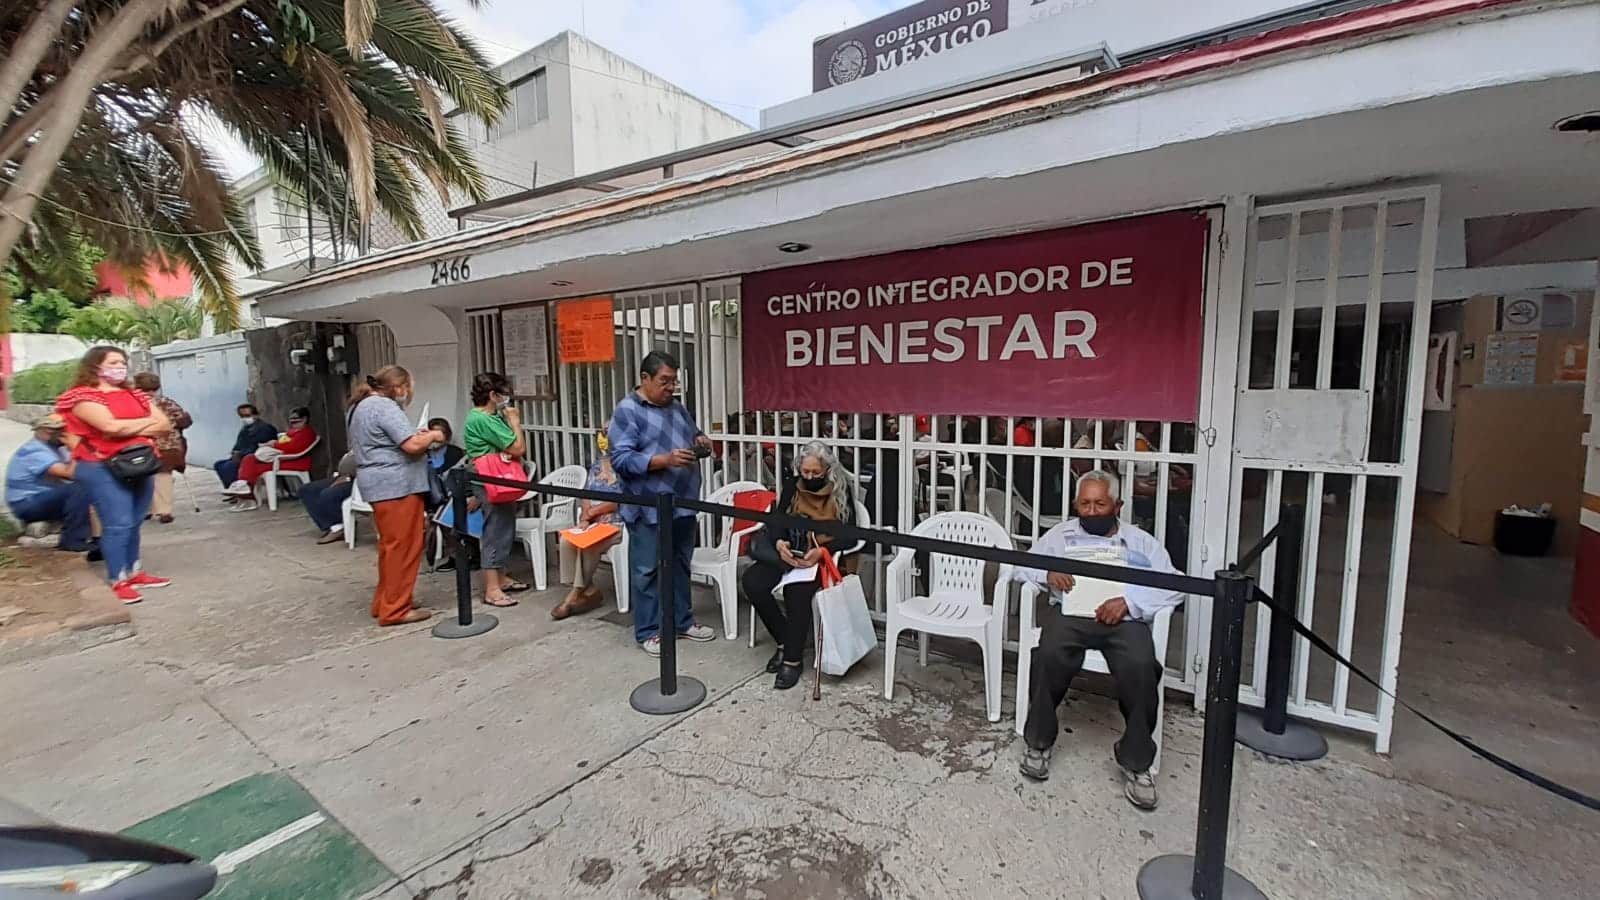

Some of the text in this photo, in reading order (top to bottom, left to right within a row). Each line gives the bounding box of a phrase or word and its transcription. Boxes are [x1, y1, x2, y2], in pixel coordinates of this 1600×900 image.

[874, 8, 962, 48] GOBIERNO
[966, 0, 991, 17] DE
[875, 18, 992, 73] MÉXICO
[431, 256, 471, 285] 2466
[767, 257, 1134, 316] CENTRO INTEGRADOR DE
[785, 310, 1098, 367] BIENESTAR
